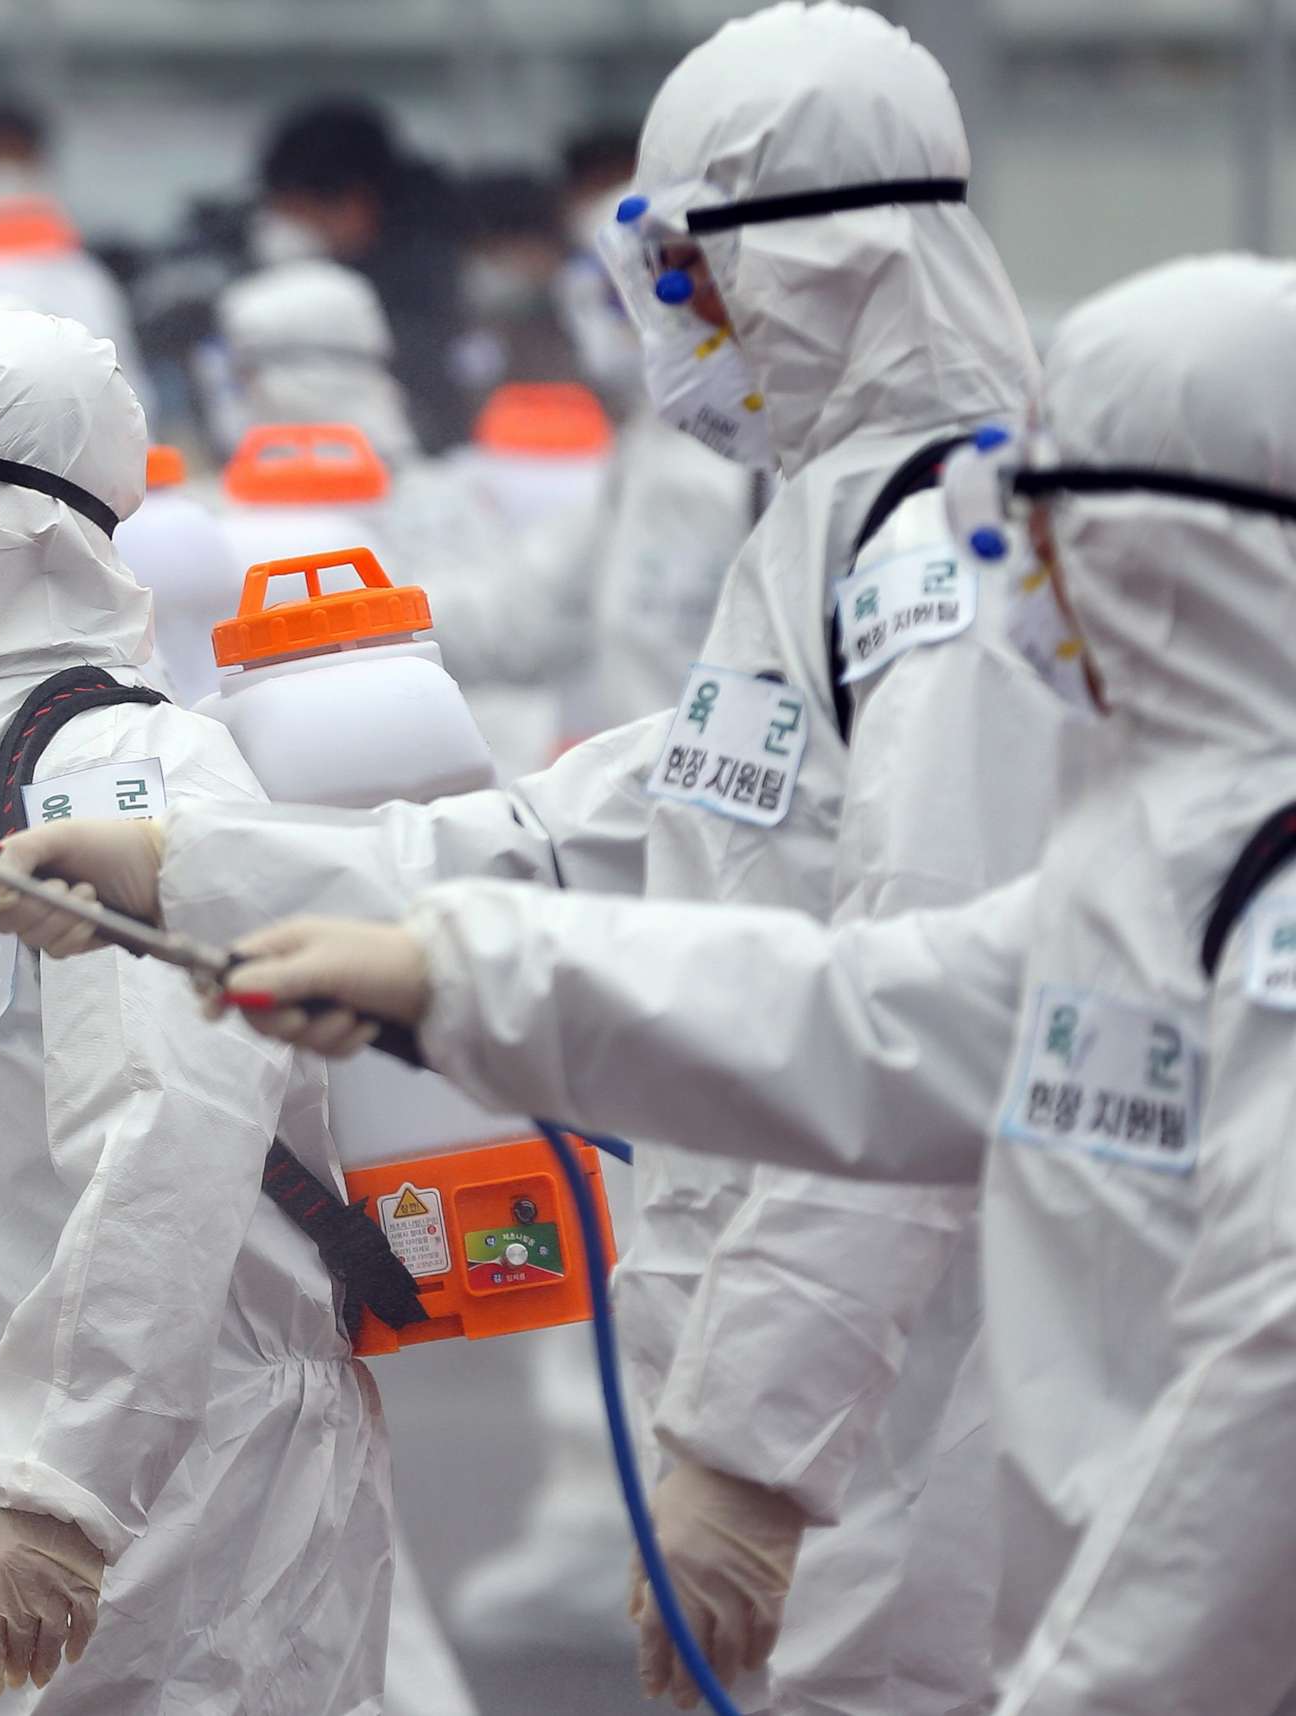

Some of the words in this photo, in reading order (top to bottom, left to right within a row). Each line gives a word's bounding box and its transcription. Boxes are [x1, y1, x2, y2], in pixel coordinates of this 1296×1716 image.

[688, 680, 720, 734] 육
[764, 698, 803, 756] 군
[116, 779, 148, 811] 군
[664, 744, 708, 788] 현장
[705, 755, 787, 810] 지원팀
